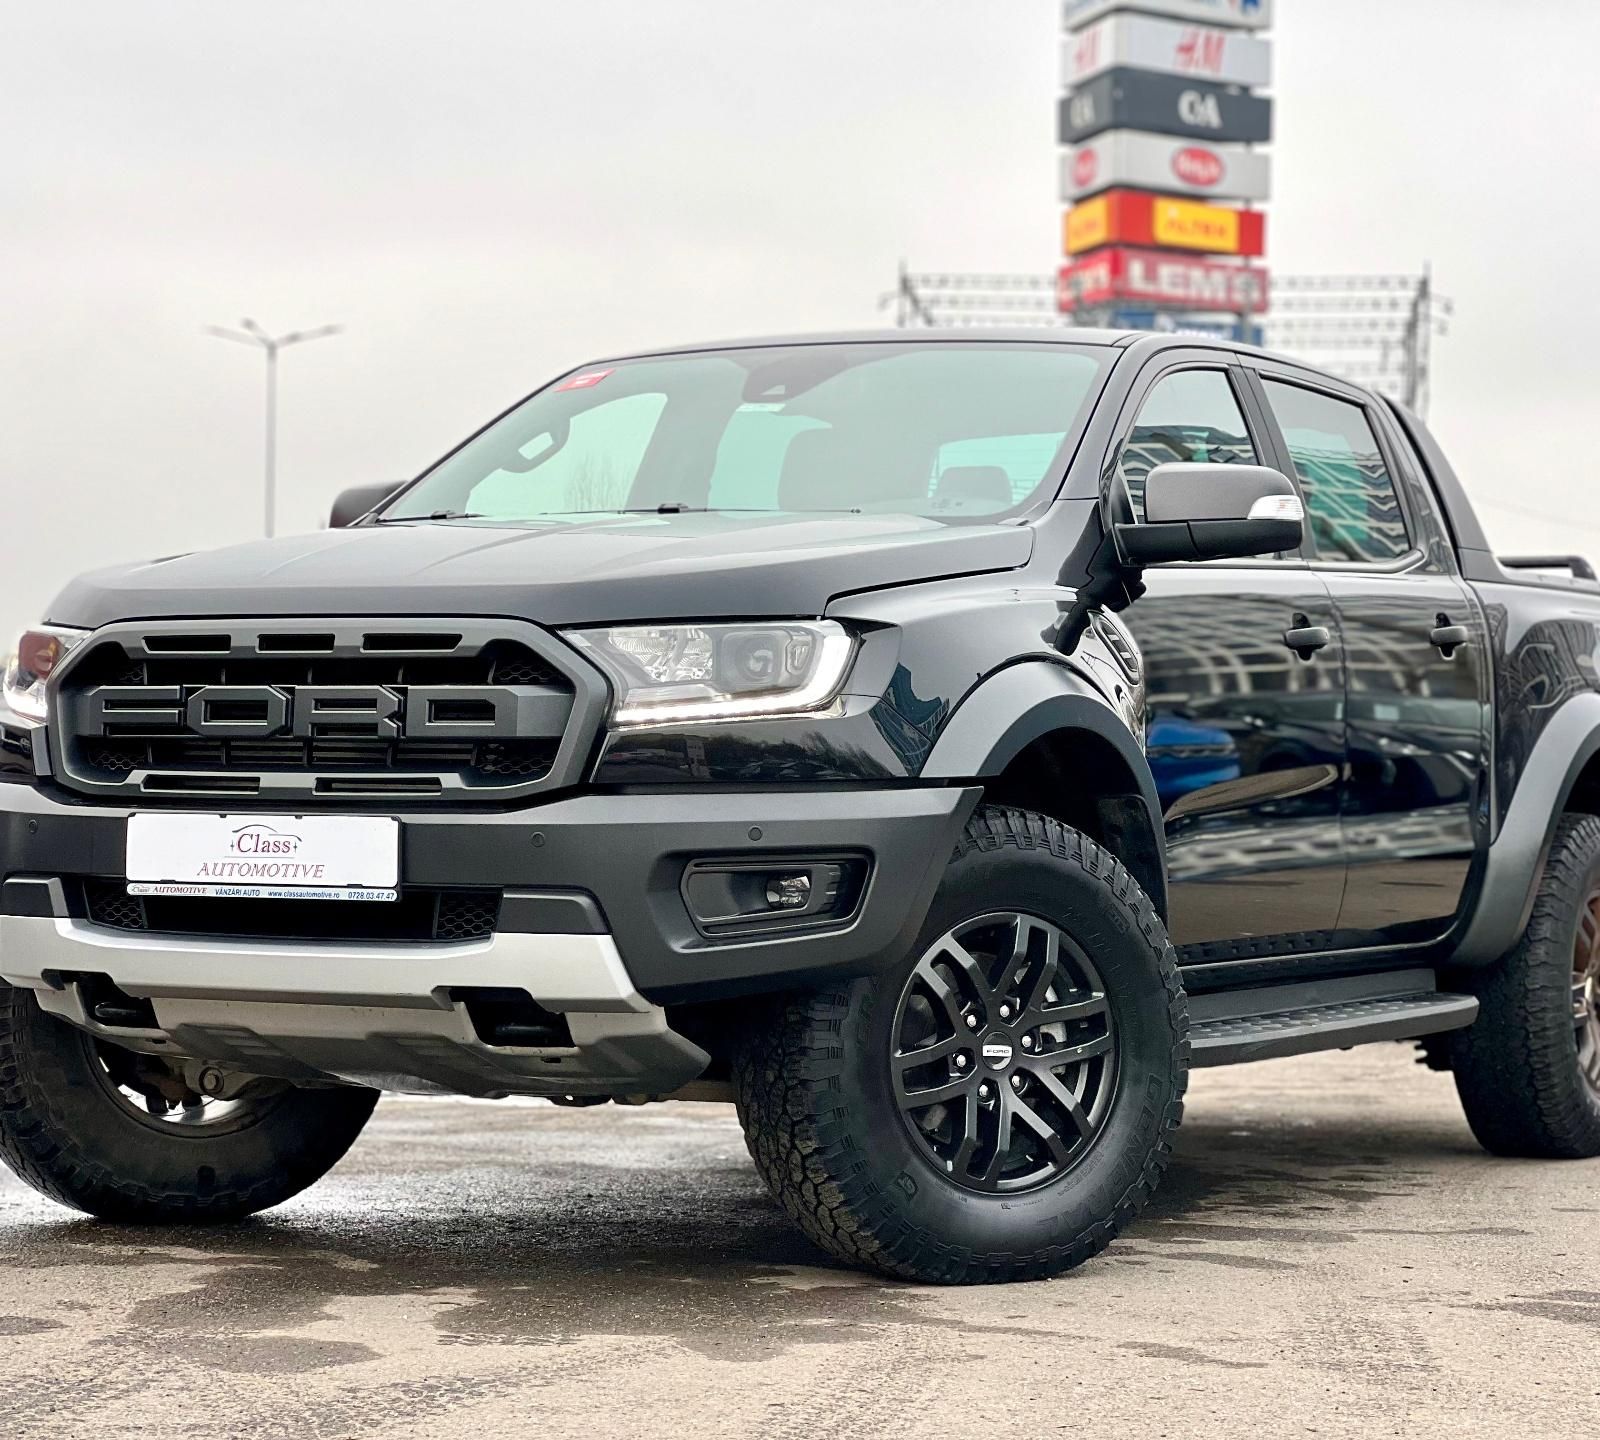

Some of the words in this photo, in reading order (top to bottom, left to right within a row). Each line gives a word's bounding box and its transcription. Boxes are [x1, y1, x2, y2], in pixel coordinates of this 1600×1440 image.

[90, 684, 522, 738] FORD
[236, 833, 291, 853] Class
[197, 862, 325, 879] AUTOMOTIVE
[153, 886, 207, 894] AUTOMOTIVE
[243, 889, 260, 897] AUTO
[267, 890, 340, 899] www.classautomotive.ro
